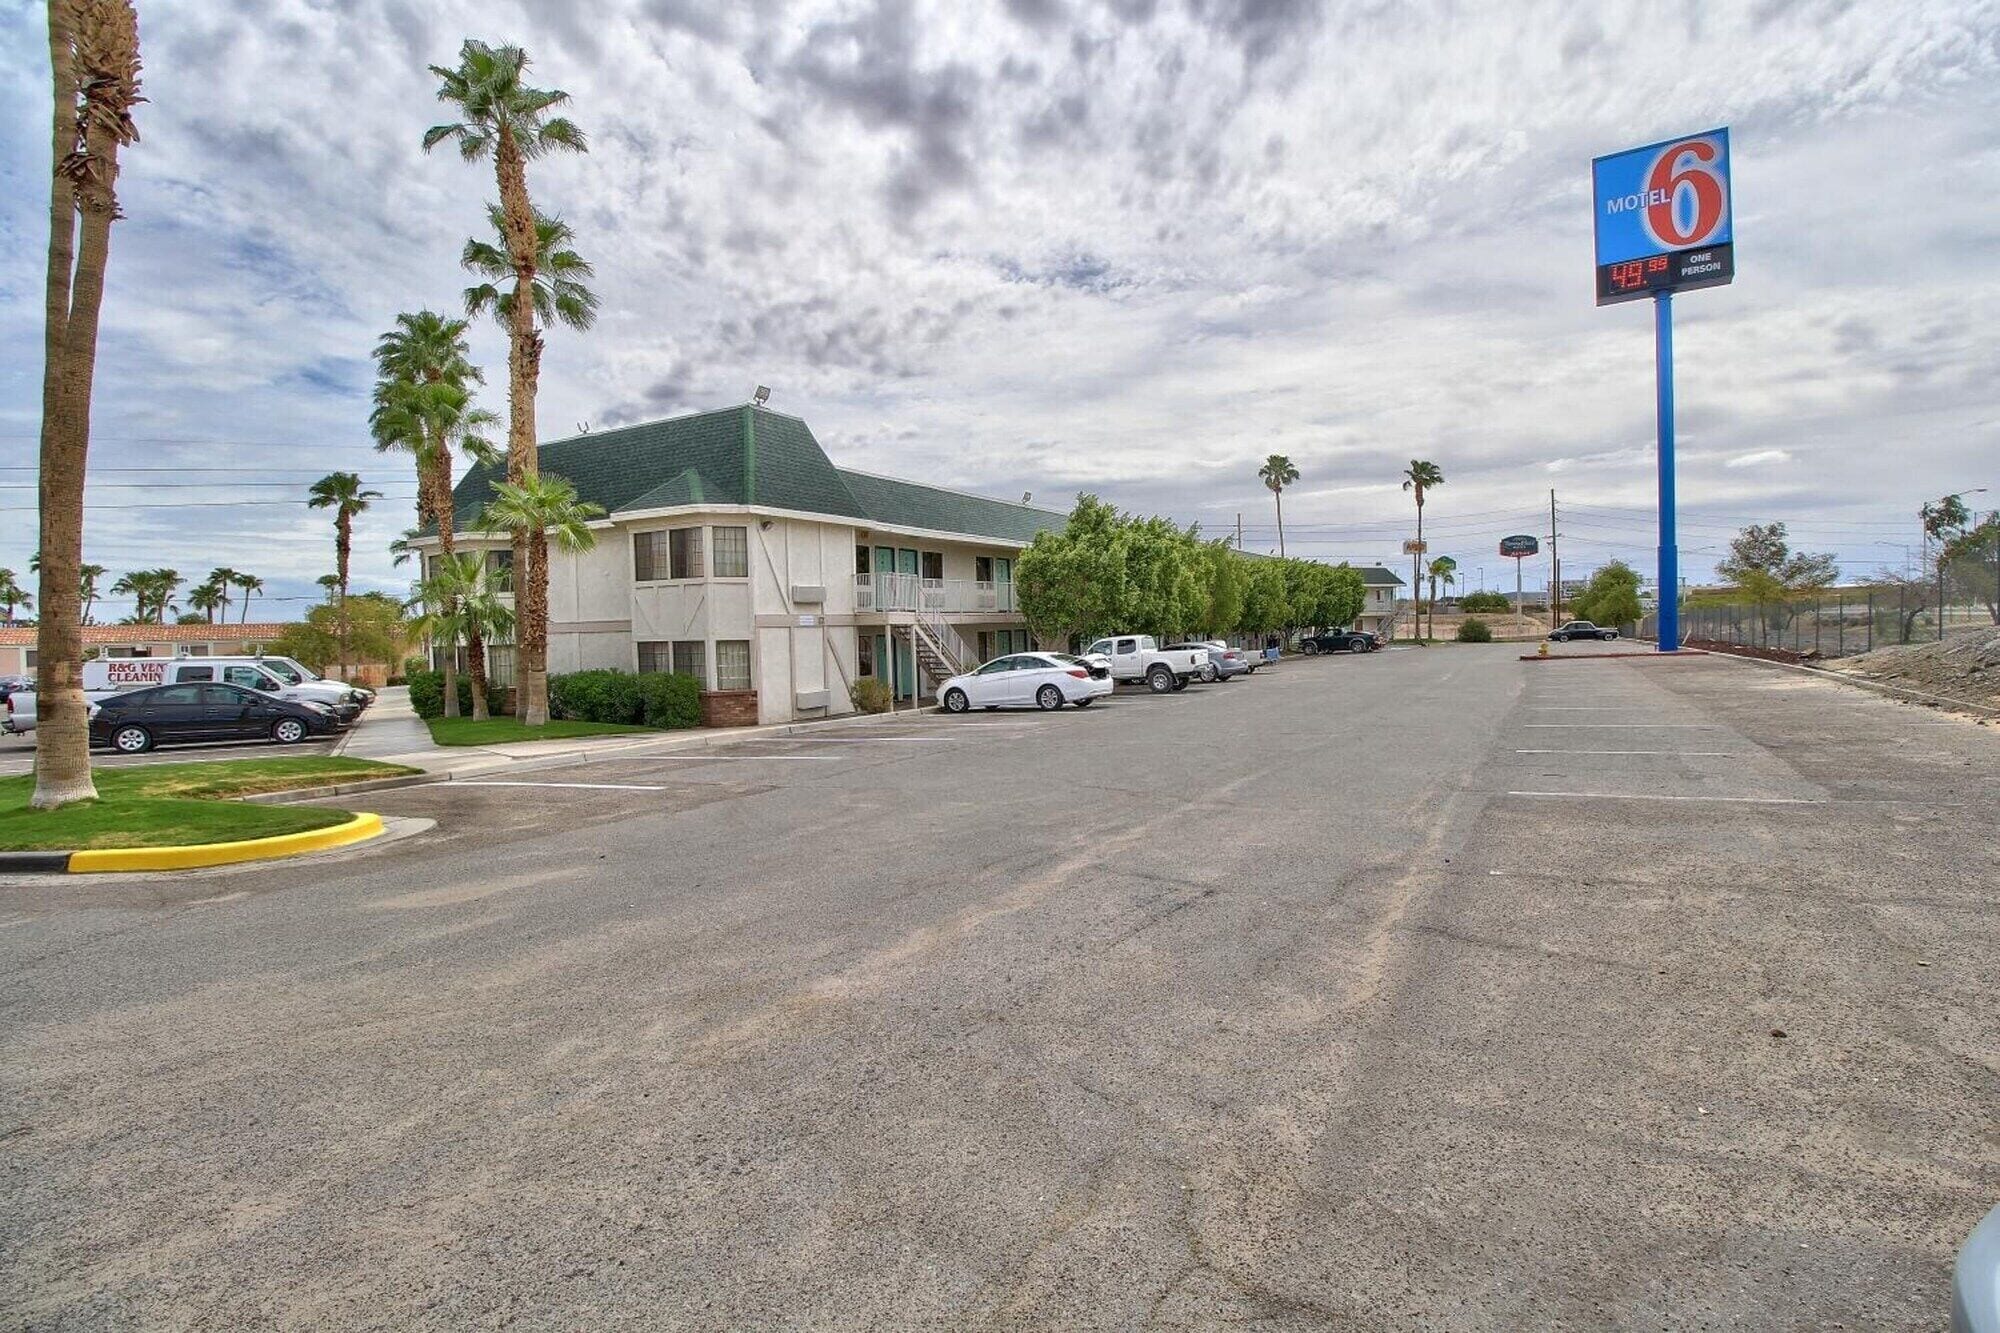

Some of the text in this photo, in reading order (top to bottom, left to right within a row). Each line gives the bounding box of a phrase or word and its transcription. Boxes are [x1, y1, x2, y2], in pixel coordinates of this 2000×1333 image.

[1607, 141, 1722, 246] MOTEL 6
[1690, 252, 1712, 264] ONE
[1681, 262, 1721, 277] PERSON
[109, 663, 167, 672] R&G VEN
